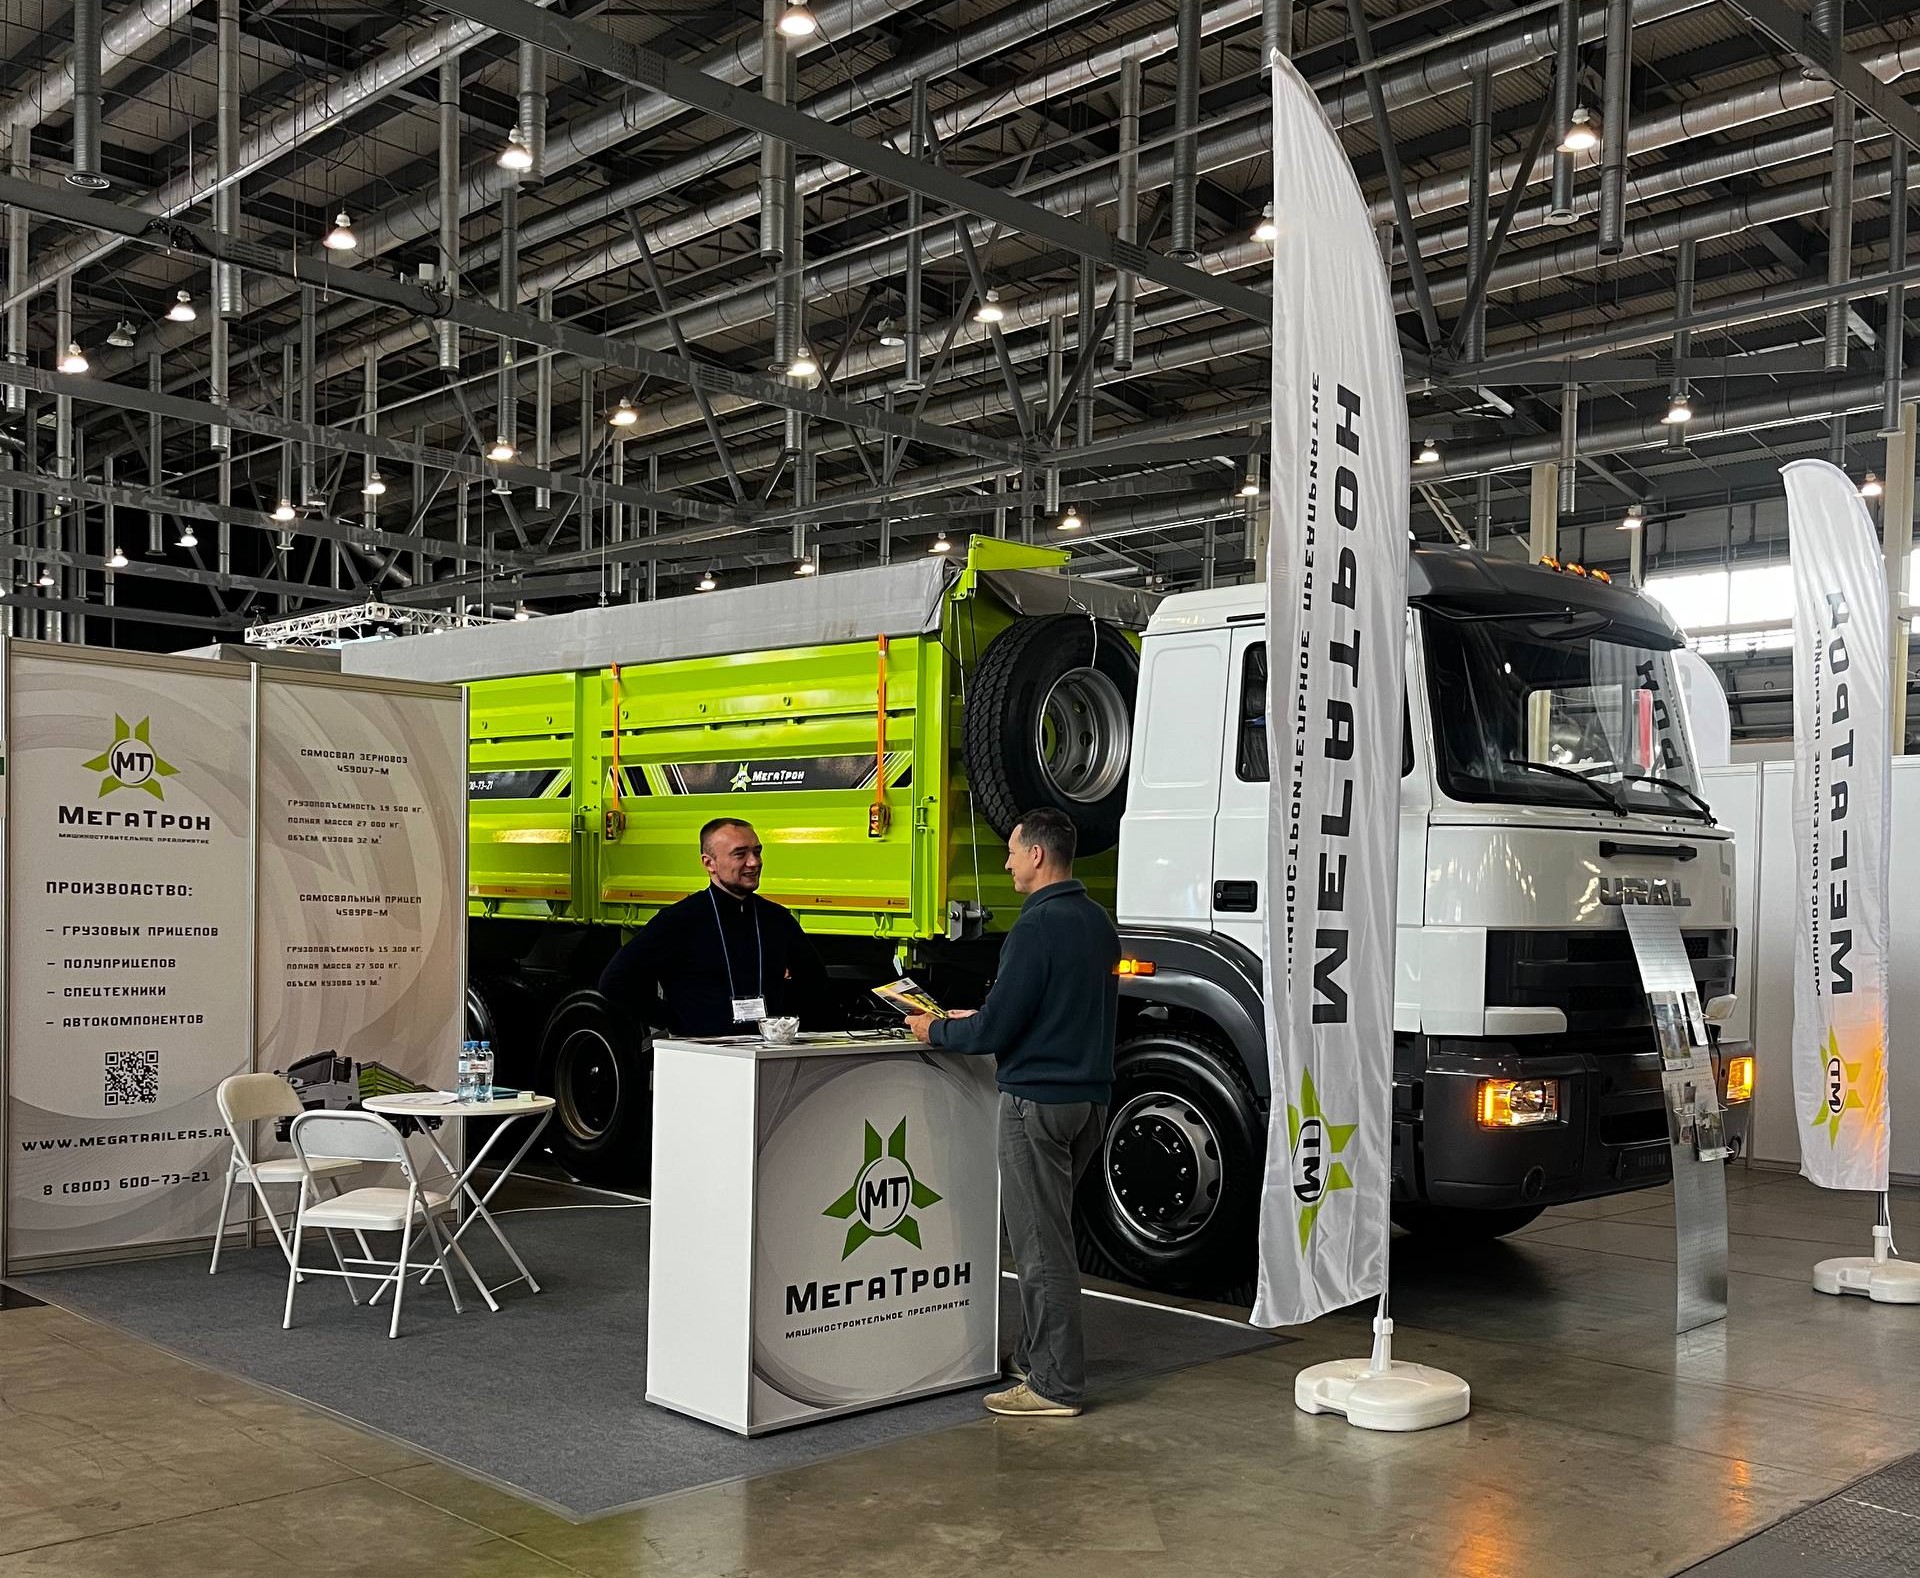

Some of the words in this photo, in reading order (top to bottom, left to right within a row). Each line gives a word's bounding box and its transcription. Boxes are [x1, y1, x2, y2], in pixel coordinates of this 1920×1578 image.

[300, 748, 355, 760] САМОСВАЛ
[359, 753, 408, 764] ЗЕРНОВОЗ
[287, 817, 321, 825] ПОЛНАЯ
[324, 818, 353, 826] МАССА
[322, 835, 353, 844] КУЗОВА
[46, 881, 193, 897] ПРОИЗВОДСТВО:
[1599, 877, 1692, 907] URAL
[299, 894, 381, 903] САМОСВАЛЬНЫЙ
[385, 895, 422, 904] ПРИЦЕП
[62, 926, 140, 936] ГРУЗОВЫХ
[148, 926, 218, 937] ПРИЦЕПОВ
[63, 958, 176, 969] ПОЛУПРИЦЕПОВ
[63, 986, 167, 997] СПЕЦТЕХНИКИ
[63, 1014, 204, 1028] АВТОКОМПОНЕНТОВ
[43, 1184, 53, 1196] 8
[119, 1171, 211, 1190] 600-73-21
[785, 1310, 904, 1340] МАШИНОСТРОИТЕЛЬНОЕ
[907, 1299, 971, 1317] ПРЕДПРИЯТИЕ
